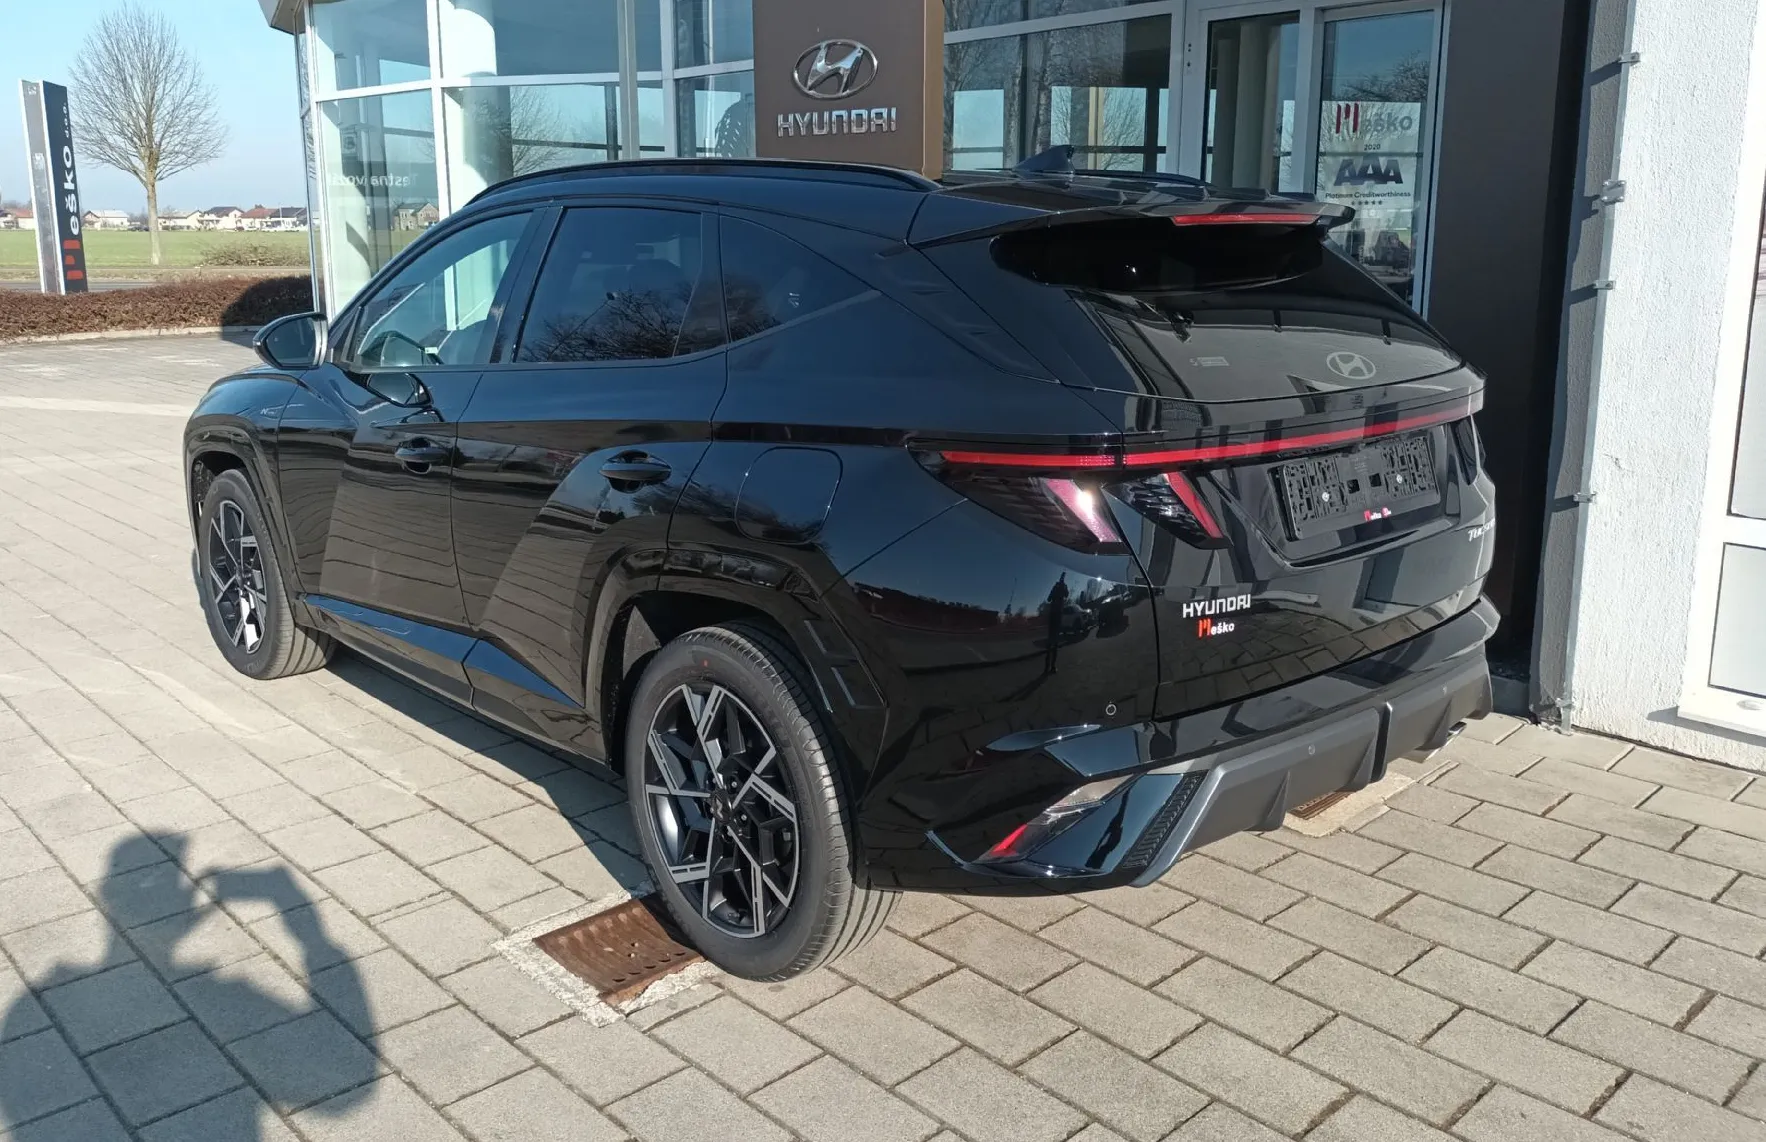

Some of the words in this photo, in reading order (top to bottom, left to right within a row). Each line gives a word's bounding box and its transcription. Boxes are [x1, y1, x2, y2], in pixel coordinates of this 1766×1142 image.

[777, 106, 897, 137] HYUNDAI
[1364, 143, 1381, 151] 2020
[1333, 153, 1404, 186] AAA
[1353, 190, 1412, 199] Creditworthiness
[1182, 593, 1252, 618] HYUNDAI
